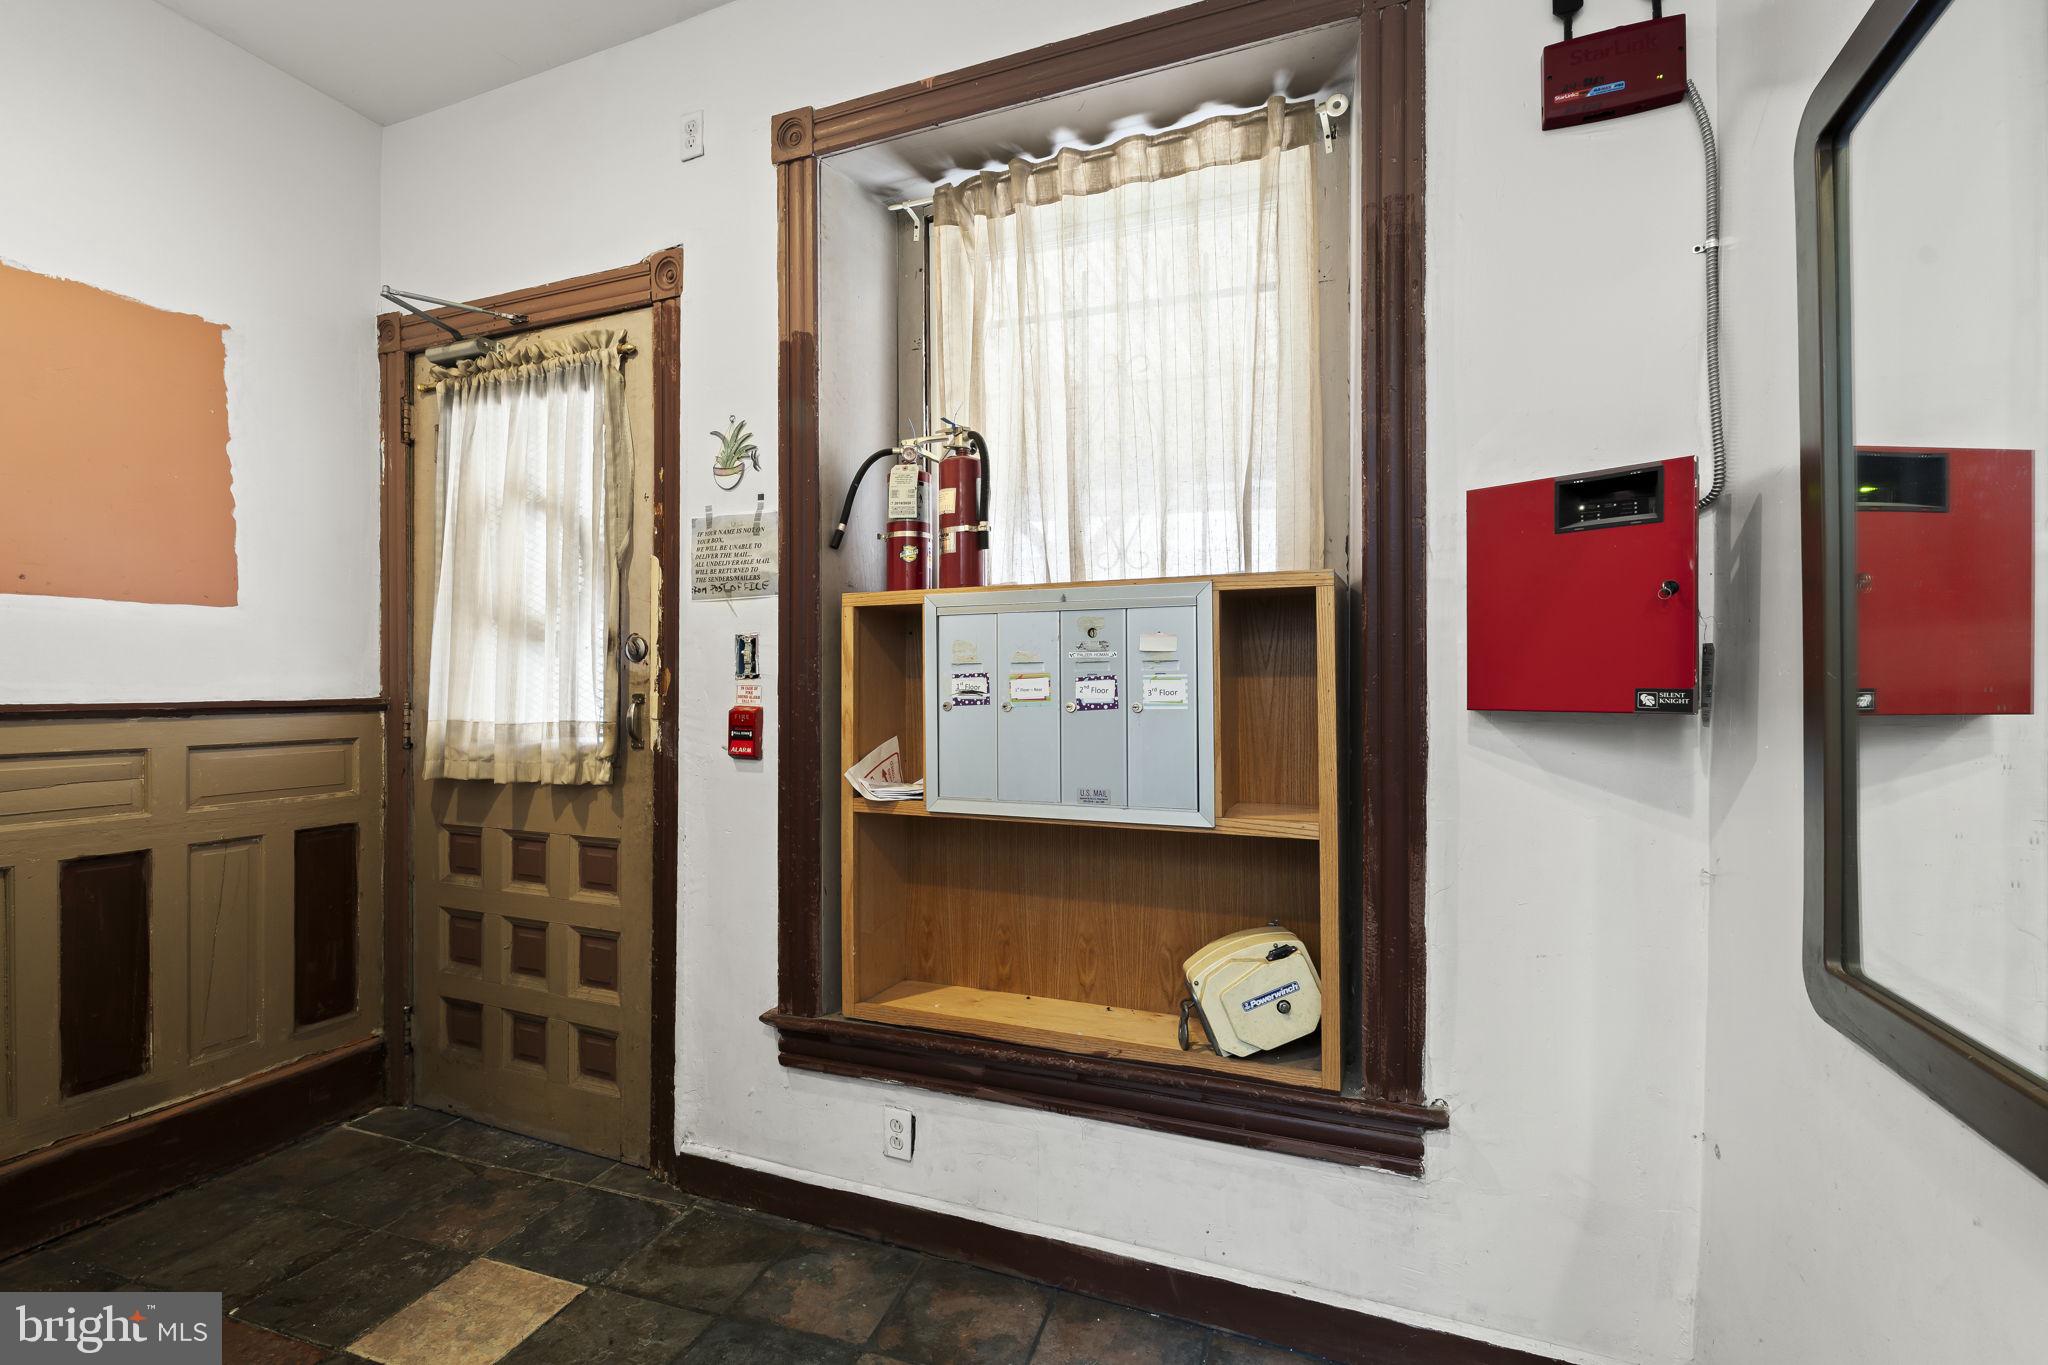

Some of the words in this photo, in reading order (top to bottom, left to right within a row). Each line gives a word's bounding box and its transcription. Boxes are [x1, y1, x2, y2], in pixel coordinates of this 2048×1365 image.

[1569, 32, 1658, 65] StarLink
[729, 543, 752, 551] UNABLE
[695, 552, 719, 560] DELIVER
[706, 559, 754, 568] UNDELIVERABLE
[718, 567, 750, 575] RETURNED
[964, 683, 981, 691] Floor
[1080, 684, 1090, 694] 2nd
[1091, 686, 1109, 694] Floor
[1148, 688, 1158, 697] 3rd
[1160, 688, 1178, 696] Floor
[1249, 983, 1298, 1009] Powerwinch
